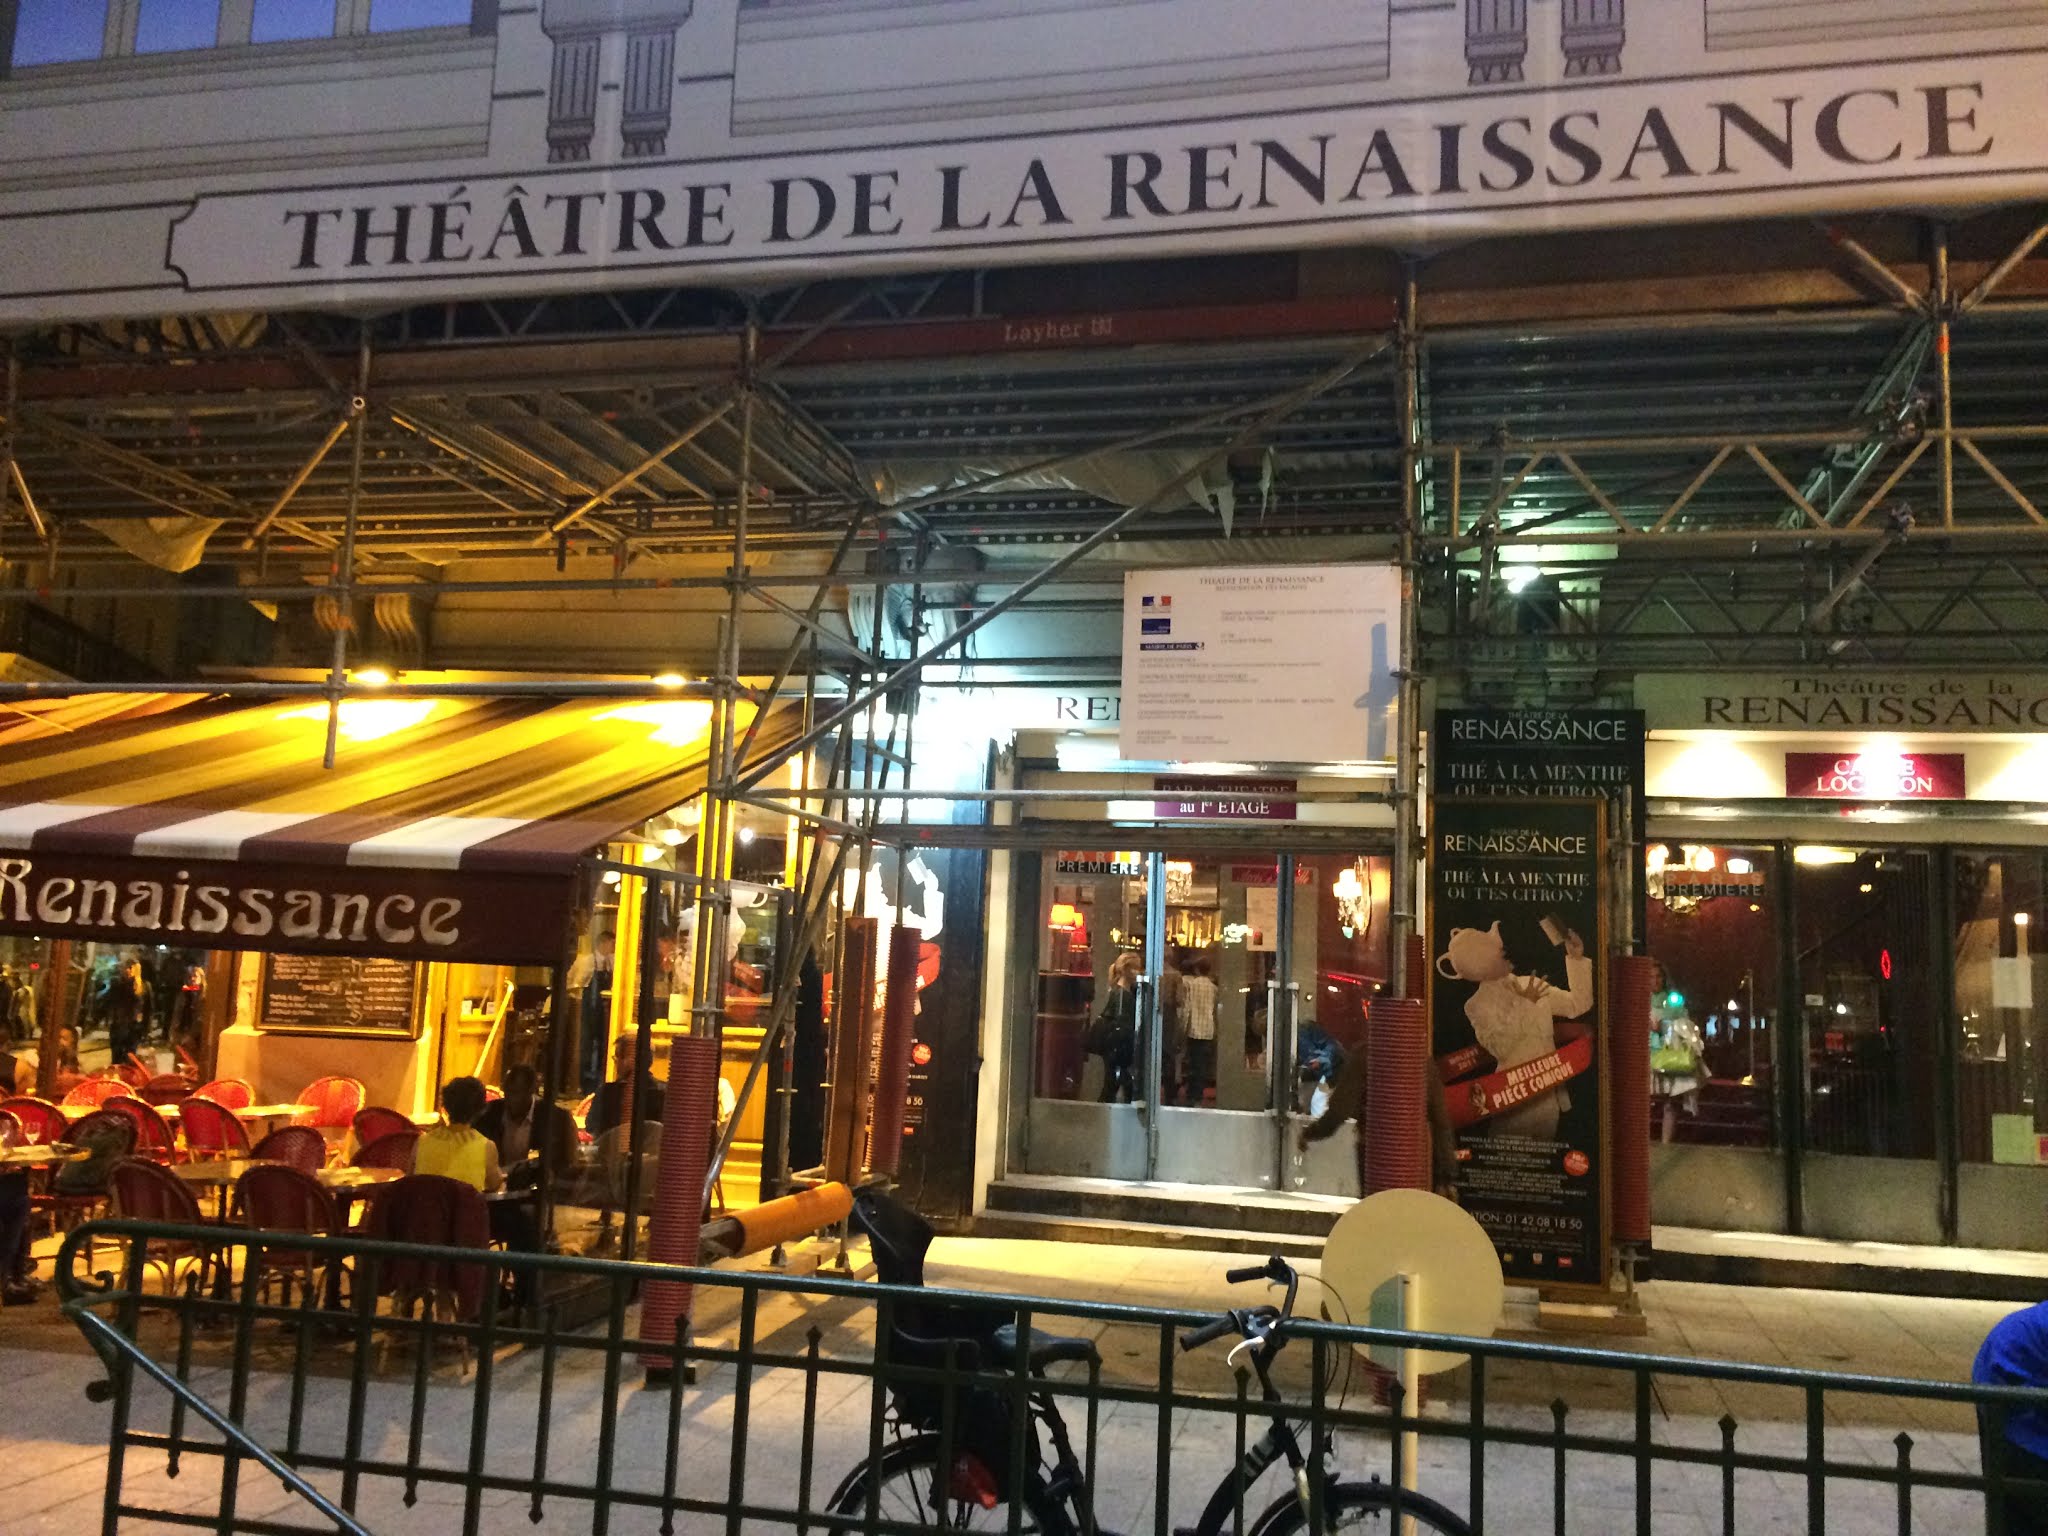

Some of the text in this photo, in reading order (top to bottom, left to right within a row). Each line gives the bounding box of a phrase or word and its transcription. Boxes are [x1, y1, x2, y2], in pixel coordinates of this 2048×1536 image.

[283, 81, 1994, 271] THÉÂTRE DE LA RENAISSANCE
[1004, 321, 1083, 344] Layher
[1782, 678, 2014, 695] Théâtre de la
[1452, 719, 1627, 741] RENAISSANCE
[1448, 760, 1488, 780] THÉ
[1512, 764, 1539, 781] LA
[1546, 764, 1631, 782] MENTHE
[1180, 803, 1195, 813] au
[1445, 835, 1587, 854] RENAISSANCE
[1442, 867, 1475, 884] THÉ
[1495, 872, 1515, 885] LA
[1521, 872, 1590, 887] MENTHE
[0, 857, 463, 946] Renaissance
[1506, 1053, 1562, 1086] MEILLEURE
[1529, 1062, 1574, 1093] COMIQUE
[912, 1096, 924, 1106] 50
[1505, 1214, 1517, 1224] 01
[1521, 1215, 1534, 1226] 42
[1537, 1217, 1551, 1227] 08
[1554, 1218, 1567, 1229] 18
[1569, 1219, 1583, 1230] 50
